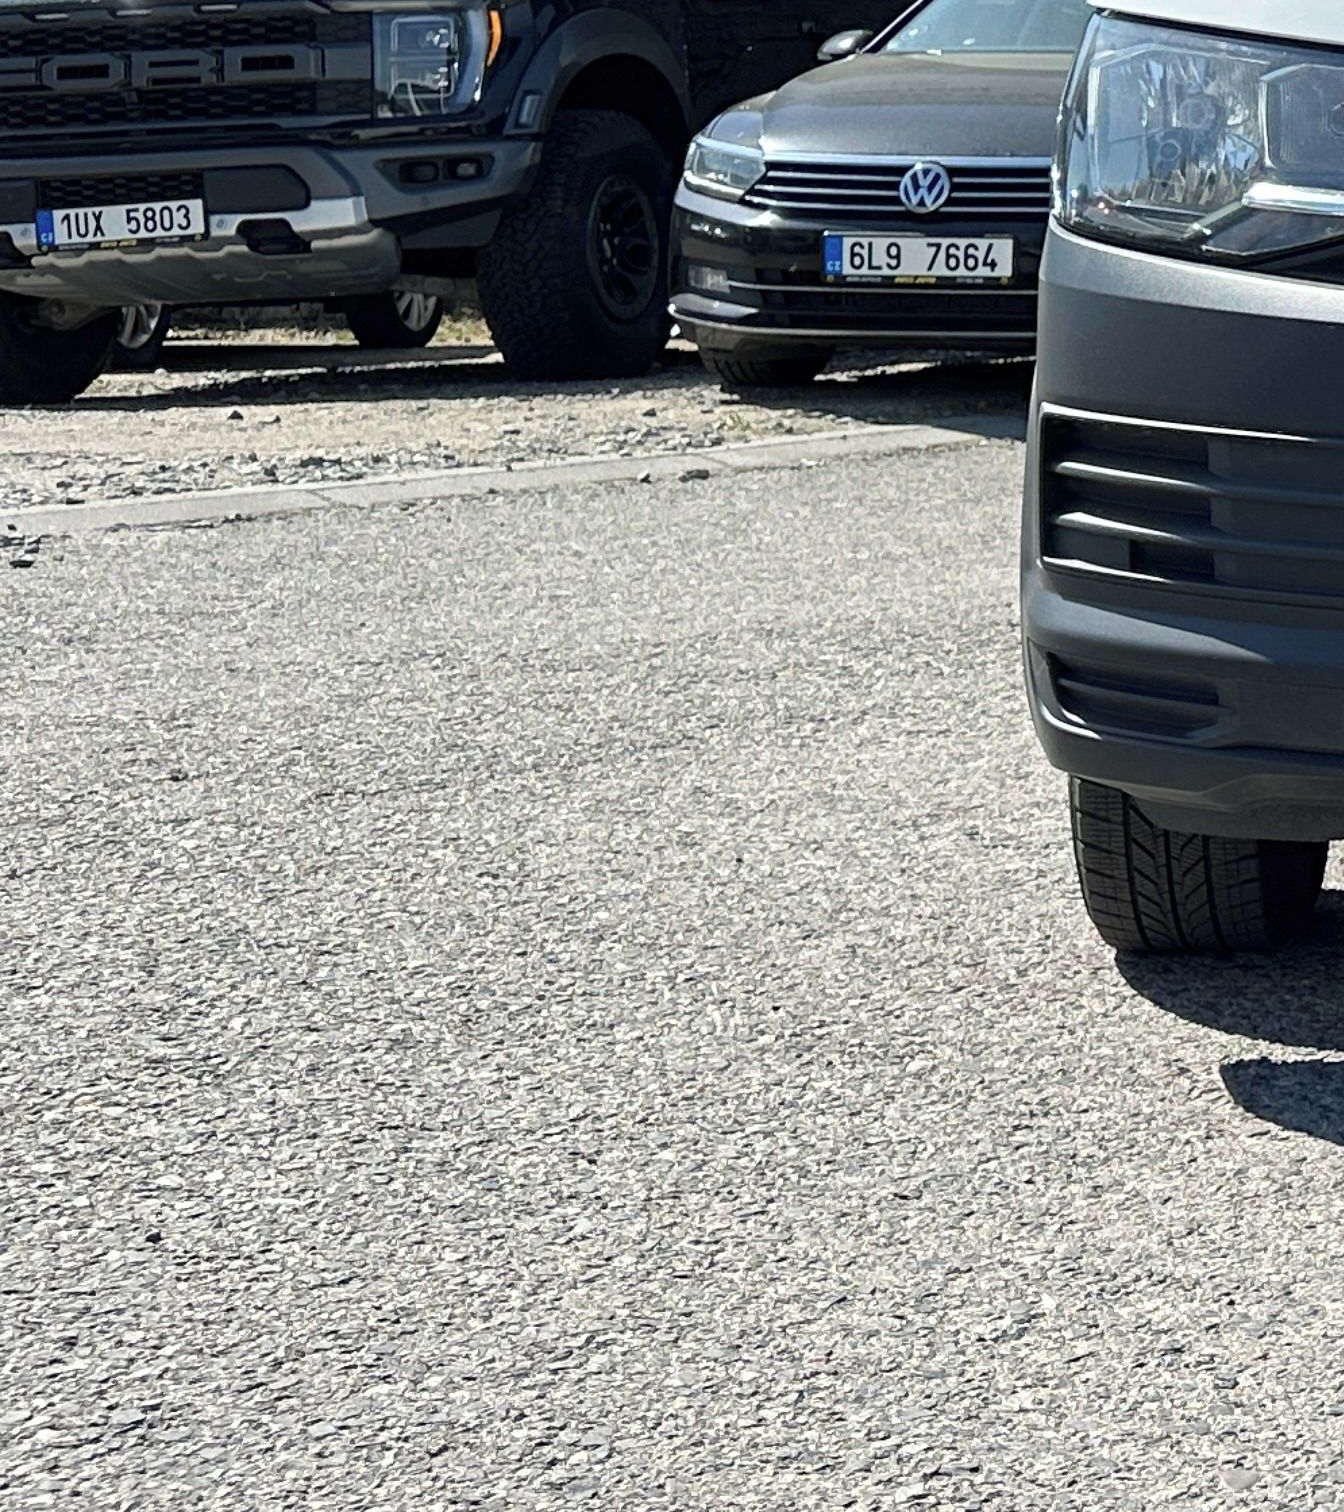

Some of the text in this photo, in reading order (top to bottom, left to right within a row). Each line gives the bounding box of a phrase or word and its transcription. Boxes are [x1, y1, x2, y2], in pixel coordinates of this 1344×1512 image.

[60, 210, 106, 241] 1UX
[125, 204, 192, 236] 5803
[849, 241, 902, 271] 6L9
[926, 242, 999, 273] 7664
